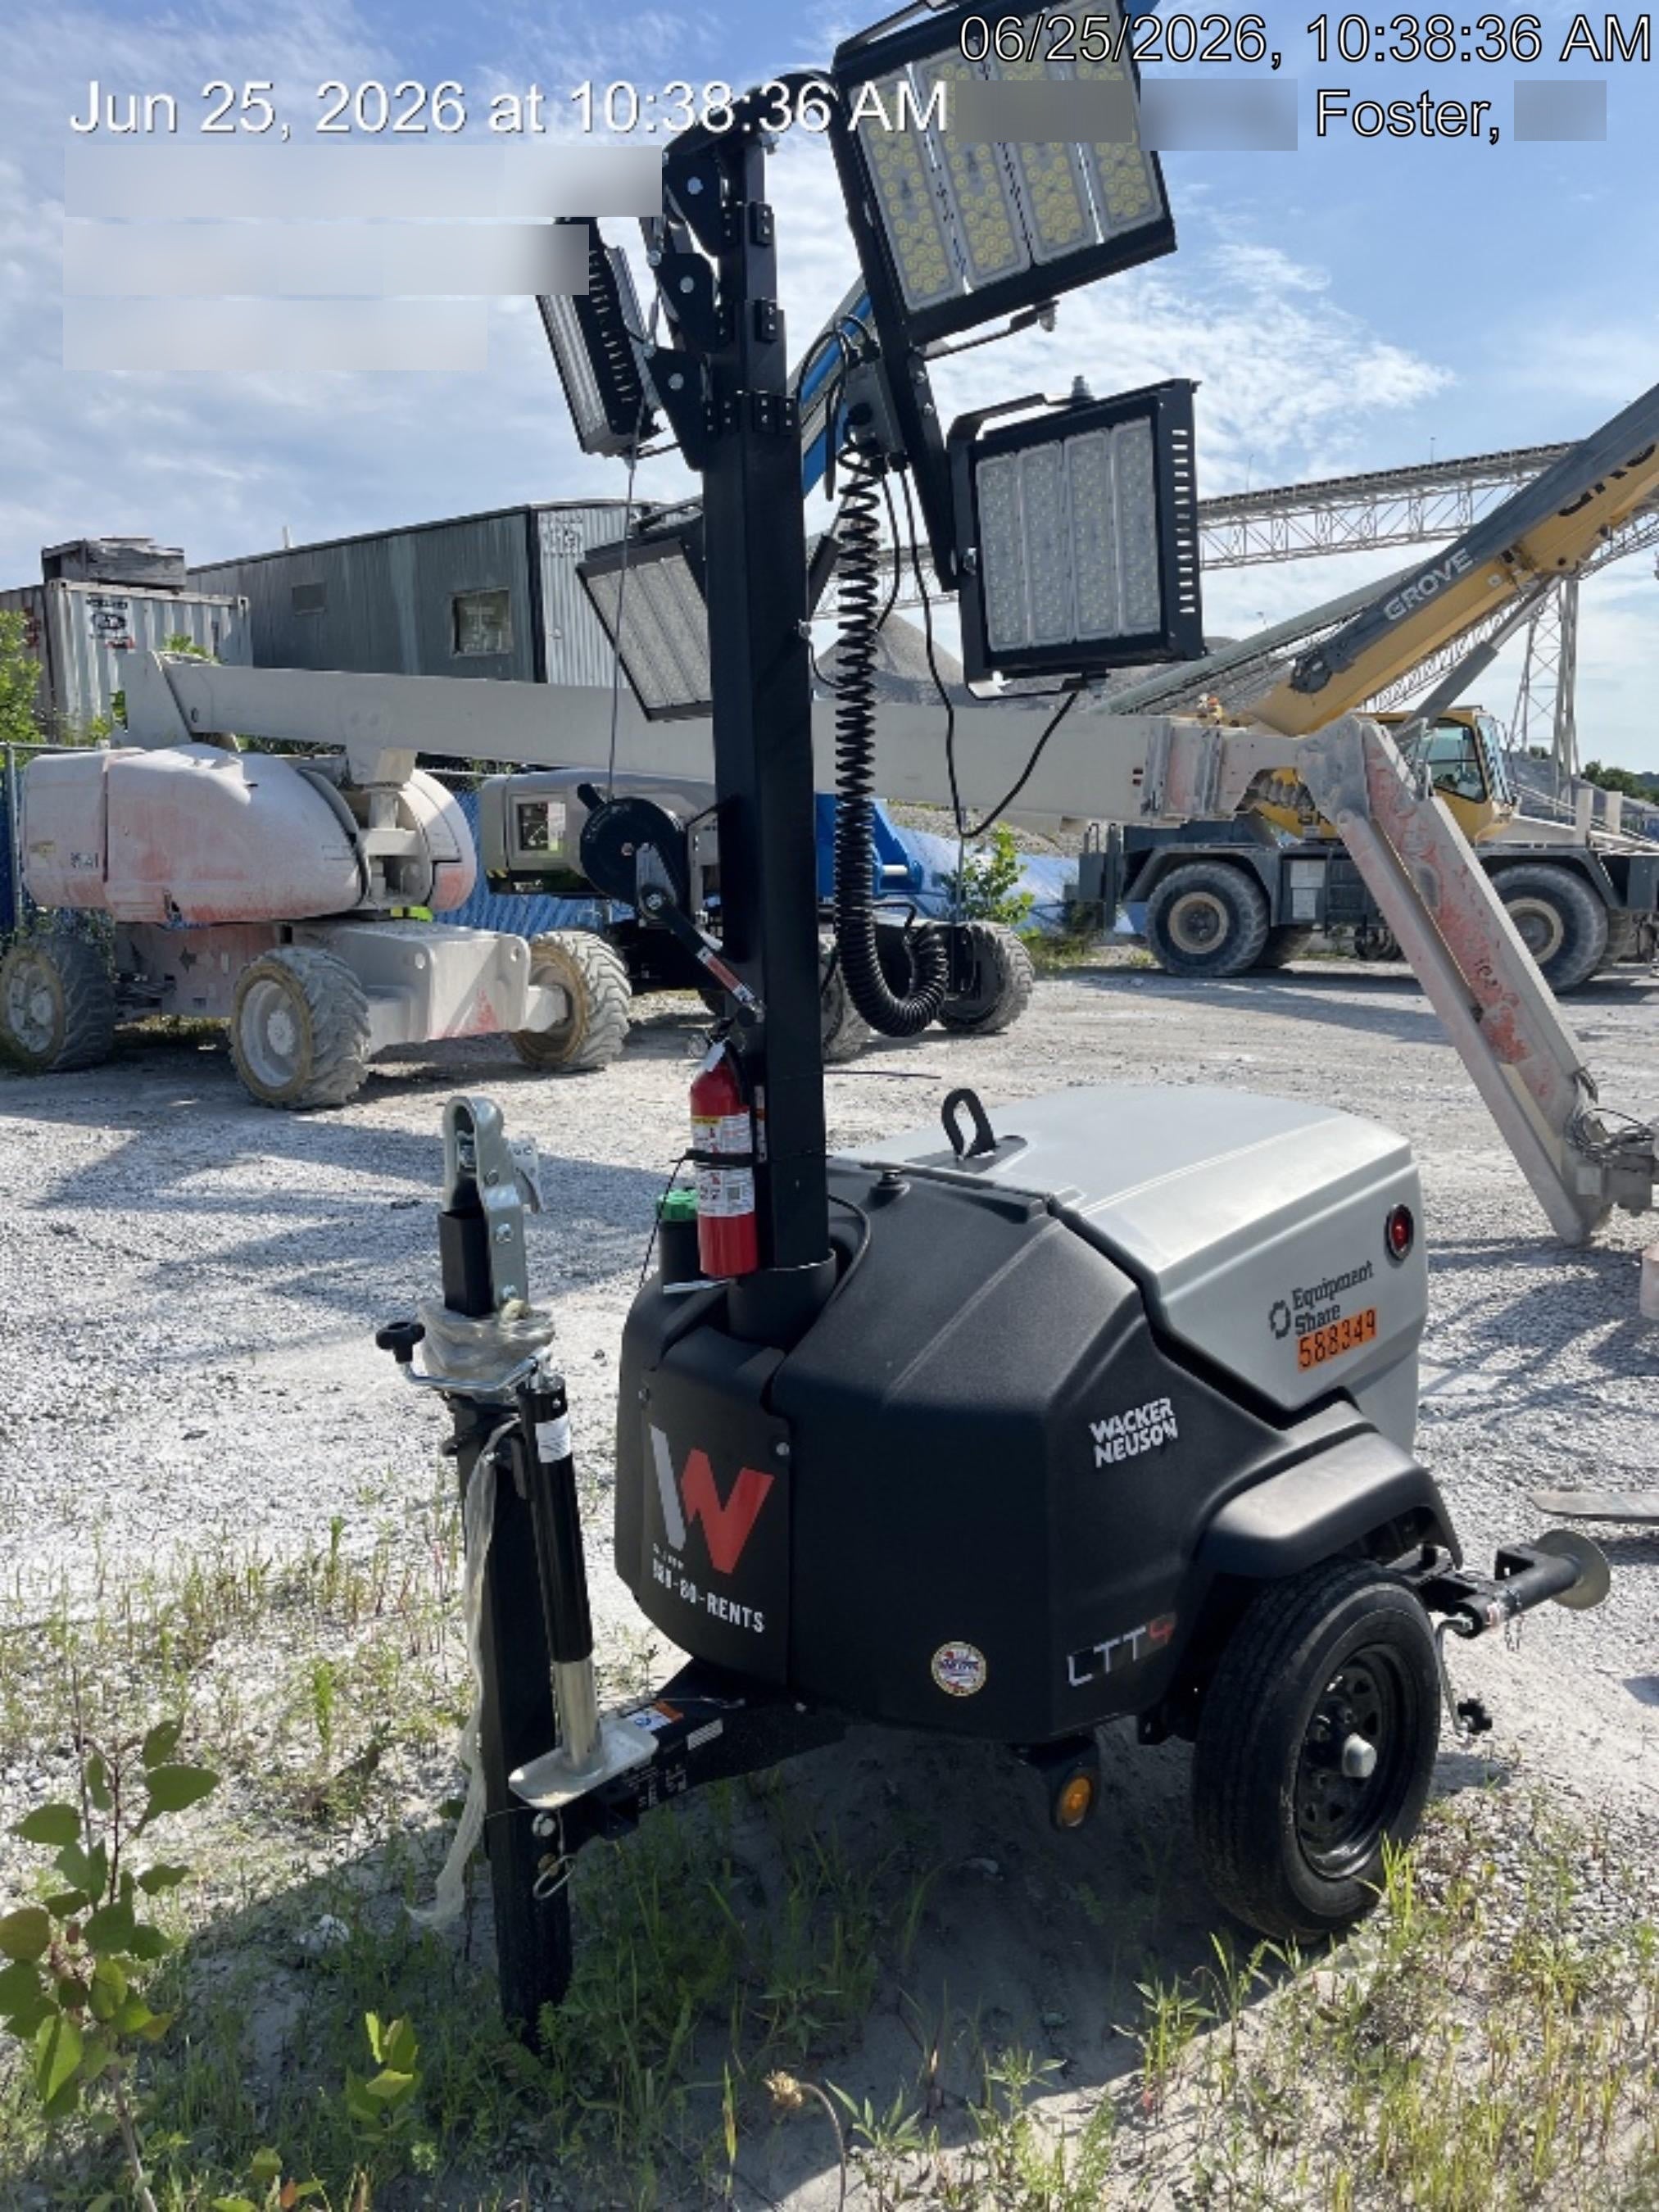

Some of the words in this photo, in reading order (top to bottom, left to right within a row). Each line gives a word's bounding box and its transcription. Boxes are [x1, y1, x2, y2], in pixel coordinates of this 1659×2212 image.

[1383, 547, 1474, 621] GROVE
[1292, 1260, 1375, 1310] Equipment
[1294, 1304, 1341, 1336] Share
[1299, 1308, 1376, 1367] 588349
[1088, 1397, 1176, 1444] WACKER
[1094, 1417, 1178, 1468] NEUSON
